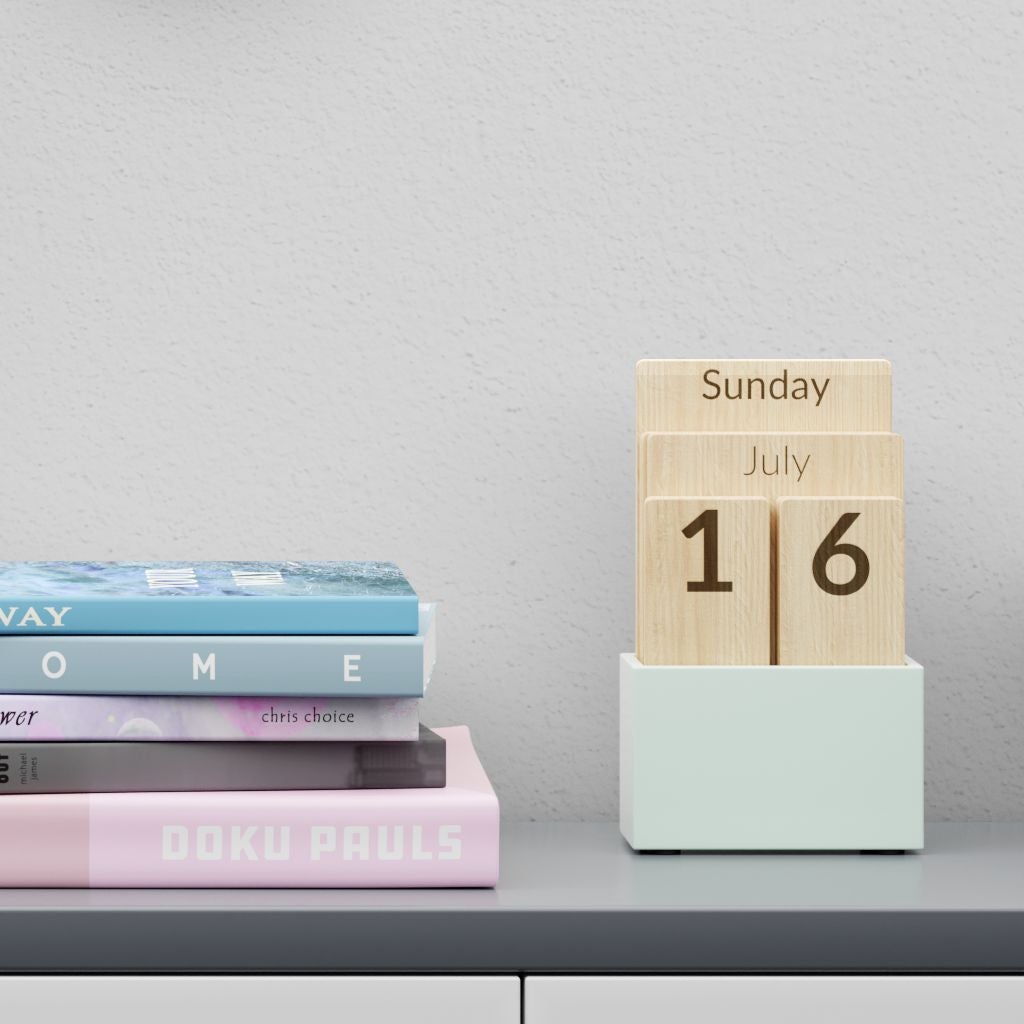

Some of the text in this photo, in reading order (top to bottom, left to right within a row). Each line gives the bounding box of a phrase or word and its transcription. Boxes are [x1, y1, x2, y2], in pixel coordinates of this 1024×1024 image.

[701, 368, 831, 407] Sunday
[743, 445, 812, 482] July
[261, 706, 356, 723] chris choice
[19, 752, 28, 785] michael
[30, 756, 39, 781] james
[161, 824, 463, 861] DOKU PAULS
